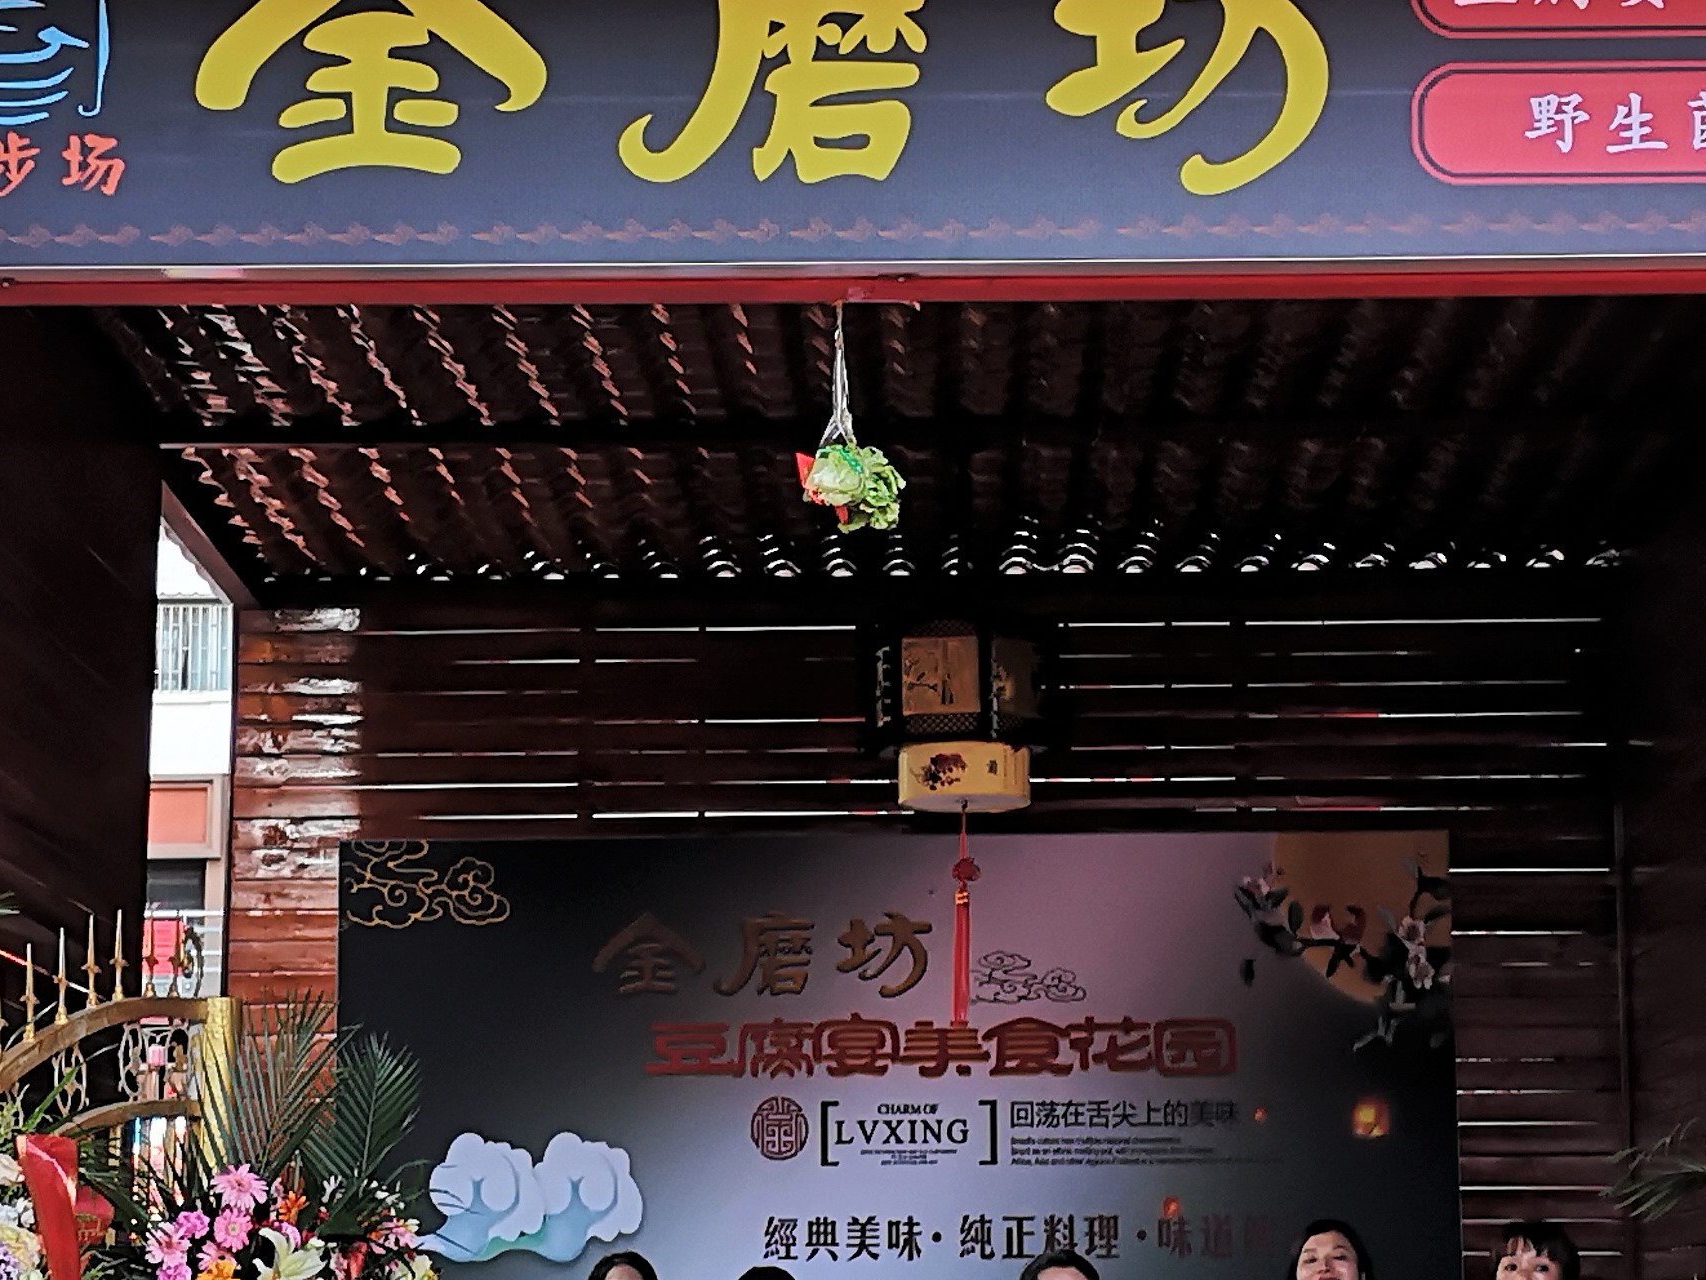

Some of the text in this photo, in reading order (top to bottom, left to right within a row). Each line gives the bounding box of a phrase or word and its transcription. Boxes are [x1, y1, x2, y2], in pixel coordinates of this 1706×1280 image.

[592, 908, 934, 998] 金磨坊
[645, 1012, 1237, 1079] 豆腐宴美食花园
